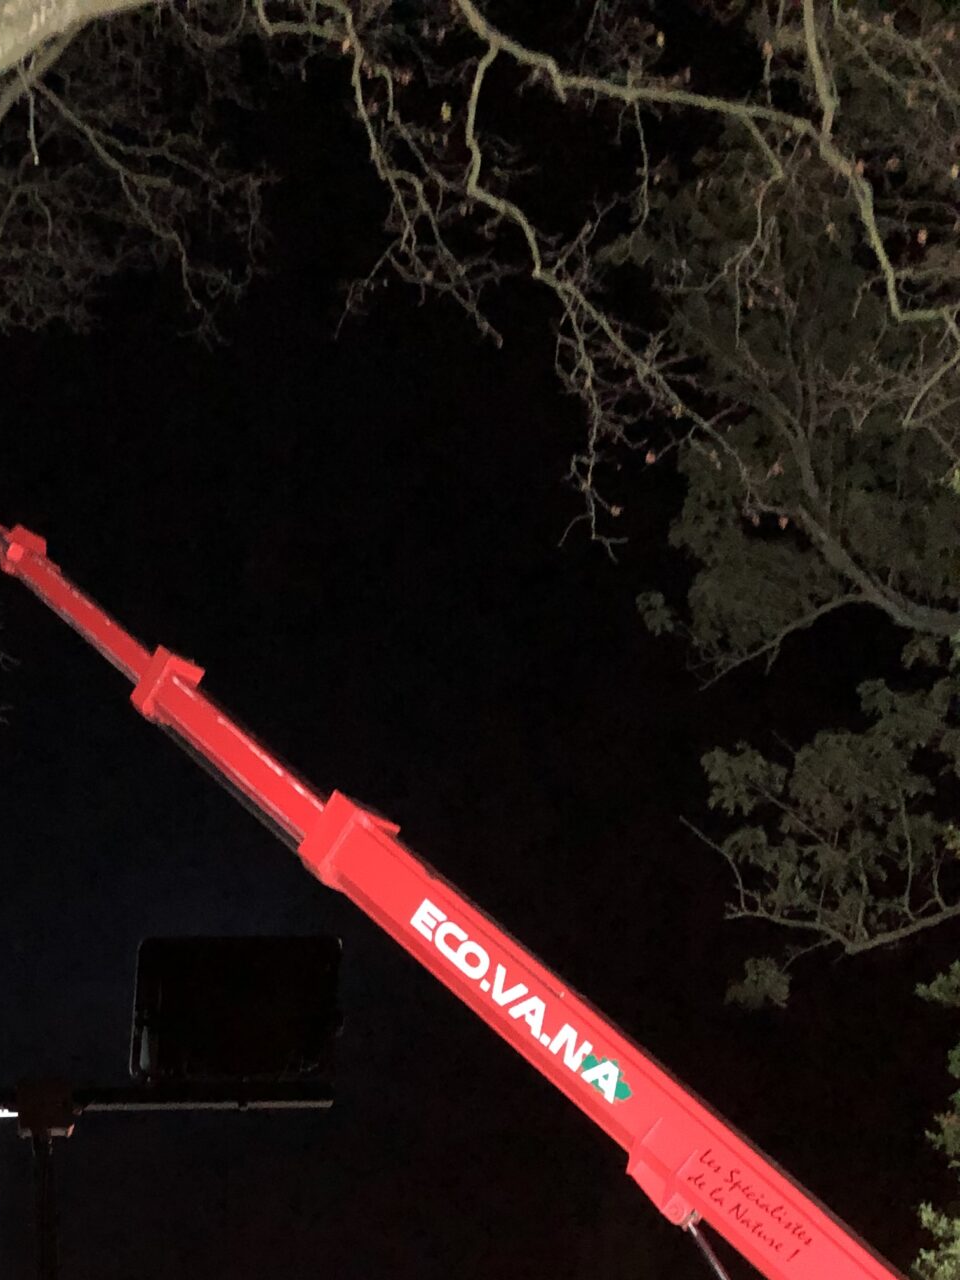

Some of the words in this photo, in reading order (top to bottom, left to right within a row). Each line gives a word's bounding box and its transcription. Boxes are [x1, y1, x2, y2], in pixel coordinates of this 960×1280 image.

[410, 898, 619, 1104] ECO.VA.NA
[700, 1149, 721, 1173] Les
[688, 1173, 706, 1190] de
[710, 1187, 724, 1207] la
[729, 1203, 783, 1252] Nature
